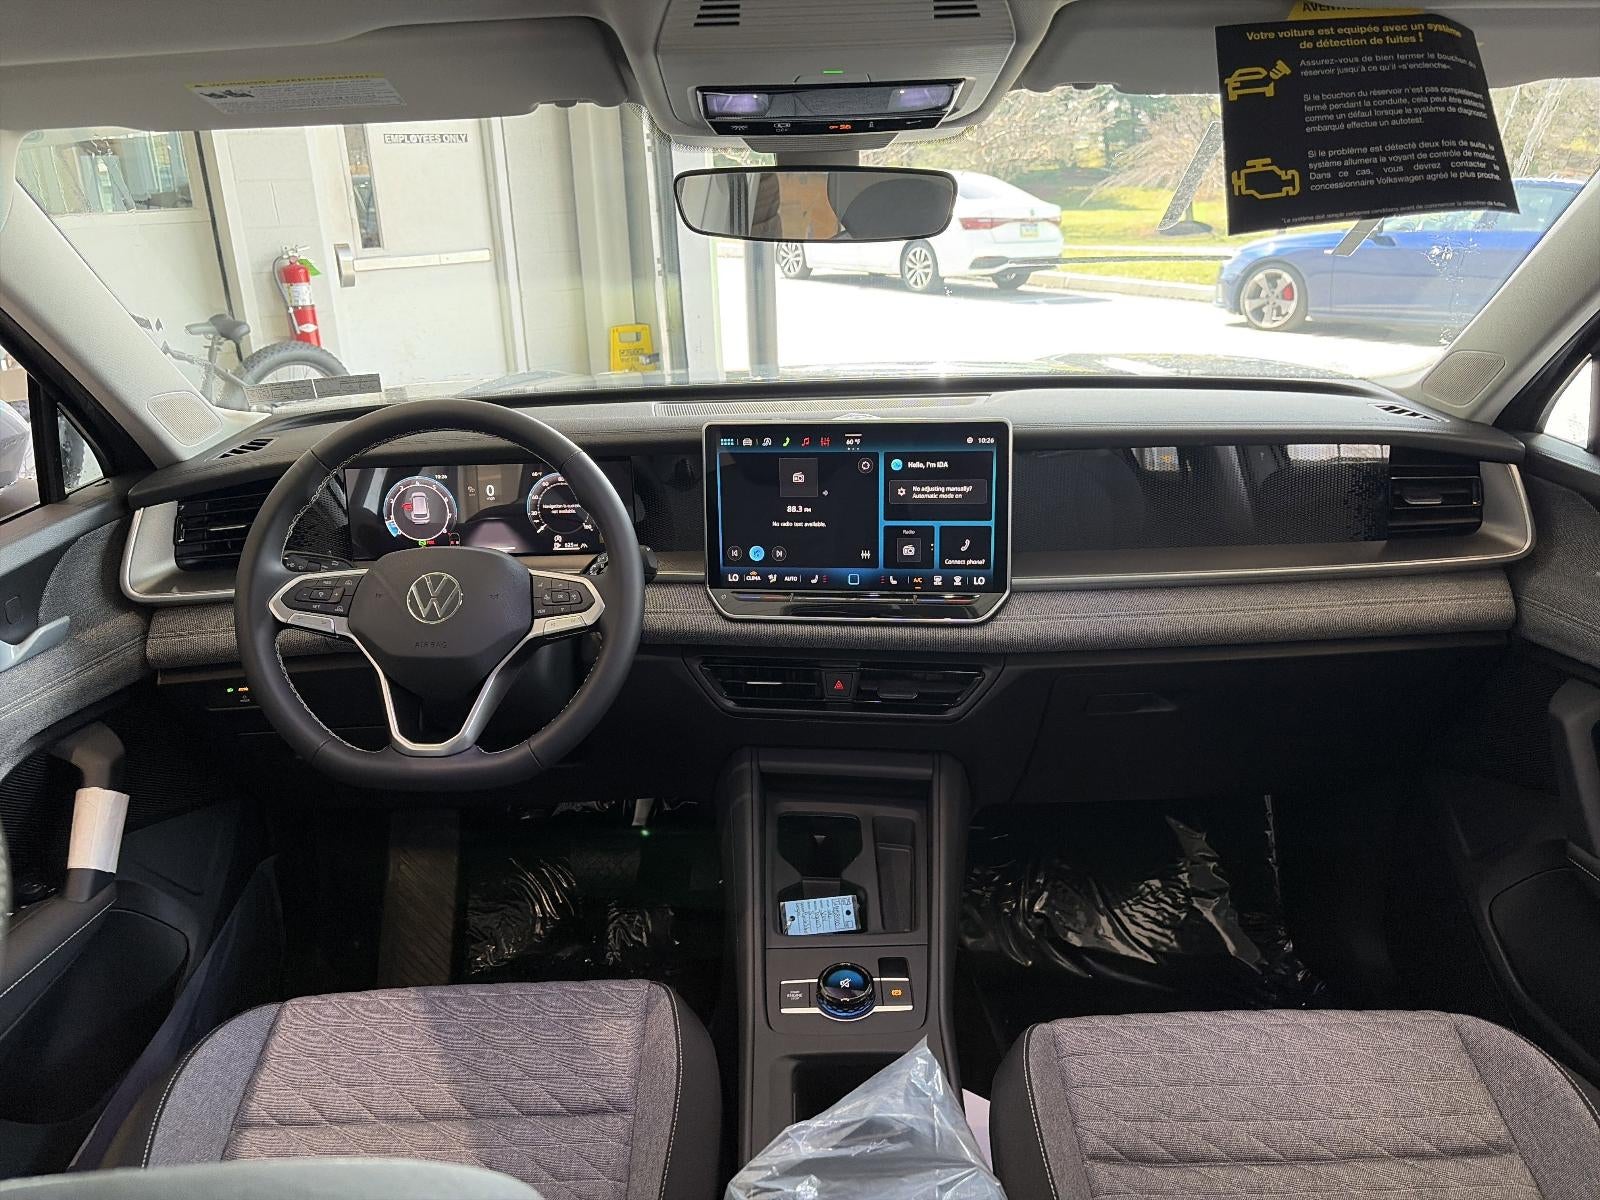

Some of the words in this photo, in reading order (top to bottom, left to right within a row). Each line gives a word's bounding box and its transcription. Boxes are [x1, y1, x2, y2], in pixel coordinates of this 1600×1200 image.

[1246, 31, 1276, 41] Votre
[1278, 28, 1315, 39] voiture
[1317, 26, 1335, 36] est
[1383, 24, 1408, 33] avec
[1411, 22, 1425, 31] un
[1300, 40, 1313, 49] de
[1316, 37, 1367, 48] détection
[1369, 36, 1383, 45] de
[1386, 34, 1416, 44] fuites
[1300, 56, 1359, 66] Assurez-vous
[1300, 67, 1336, 77] réservoir
[1322, 91, 1356, 100] bouchon
[1370, 88, 1403, 96] réservoir
[1304, 103, 1327, 112] fermé
[1329, 100, 1362, 110] pendant
[1430, 96, 1447, 104] peut
[1305, 114, 1334, 122] comme
[1348, 110, 1372, 118] défaut
[1374, 108, 1403, 117] lorsque
[1413, 105, 1445, 113] système
[1305, 123, 1345, 132] embarqué
[1346, 120, 1378, 129] effectue
[1379, 119, 1389, 127] un
[384, 134, 440, 143] EMPLOYEES
[442, 134, 467, 143] ONLY
[1307, 150, 1316, 158] Si
[1318, 149, 1326, 157] le
[1328, 146, 1368, 157] problème
[1384, 141, 1417, 151] détecté
[1419, 140, 1440, 148] deux
[1441, 139, 1457, 147] fois
[1309, 159, 1342, 170] système
[1343, 157, 1378, 166] allumera
[1379, 155, 1387, 163] le
[1388, 153, 1415, 163] voyant
[1429, 149, 1460, 158] contrôle
[1309, 171, 1331, 180] Dans
[1382, 165, 1404, 173] vous
[1413, 162, 1441, 170] devrez
[1450, 160, 1487, 168] contacter
[1492, 163, 1500, 171] le
[1310, 180, 1375, 191] concessionnaire
[1376, 175, 1424, 185] Volkswagen
[1450, 170, 1458, 178] le
[1460, 170, 1476, 179] plus
[908, 461, 925, 469] Hello,
[486, 484, 495, 497] 0
[921, 485, 945, 493] adjusting
[946, 485, 973, 493] manually?
[786, 505, 803, 513] 88.3
[966, 558, 986, 566] phone?
[727, 573, 740, 582] LO
[973, 576, 986, 586] LO
[415, 641, 448, 649] AIRBAG
